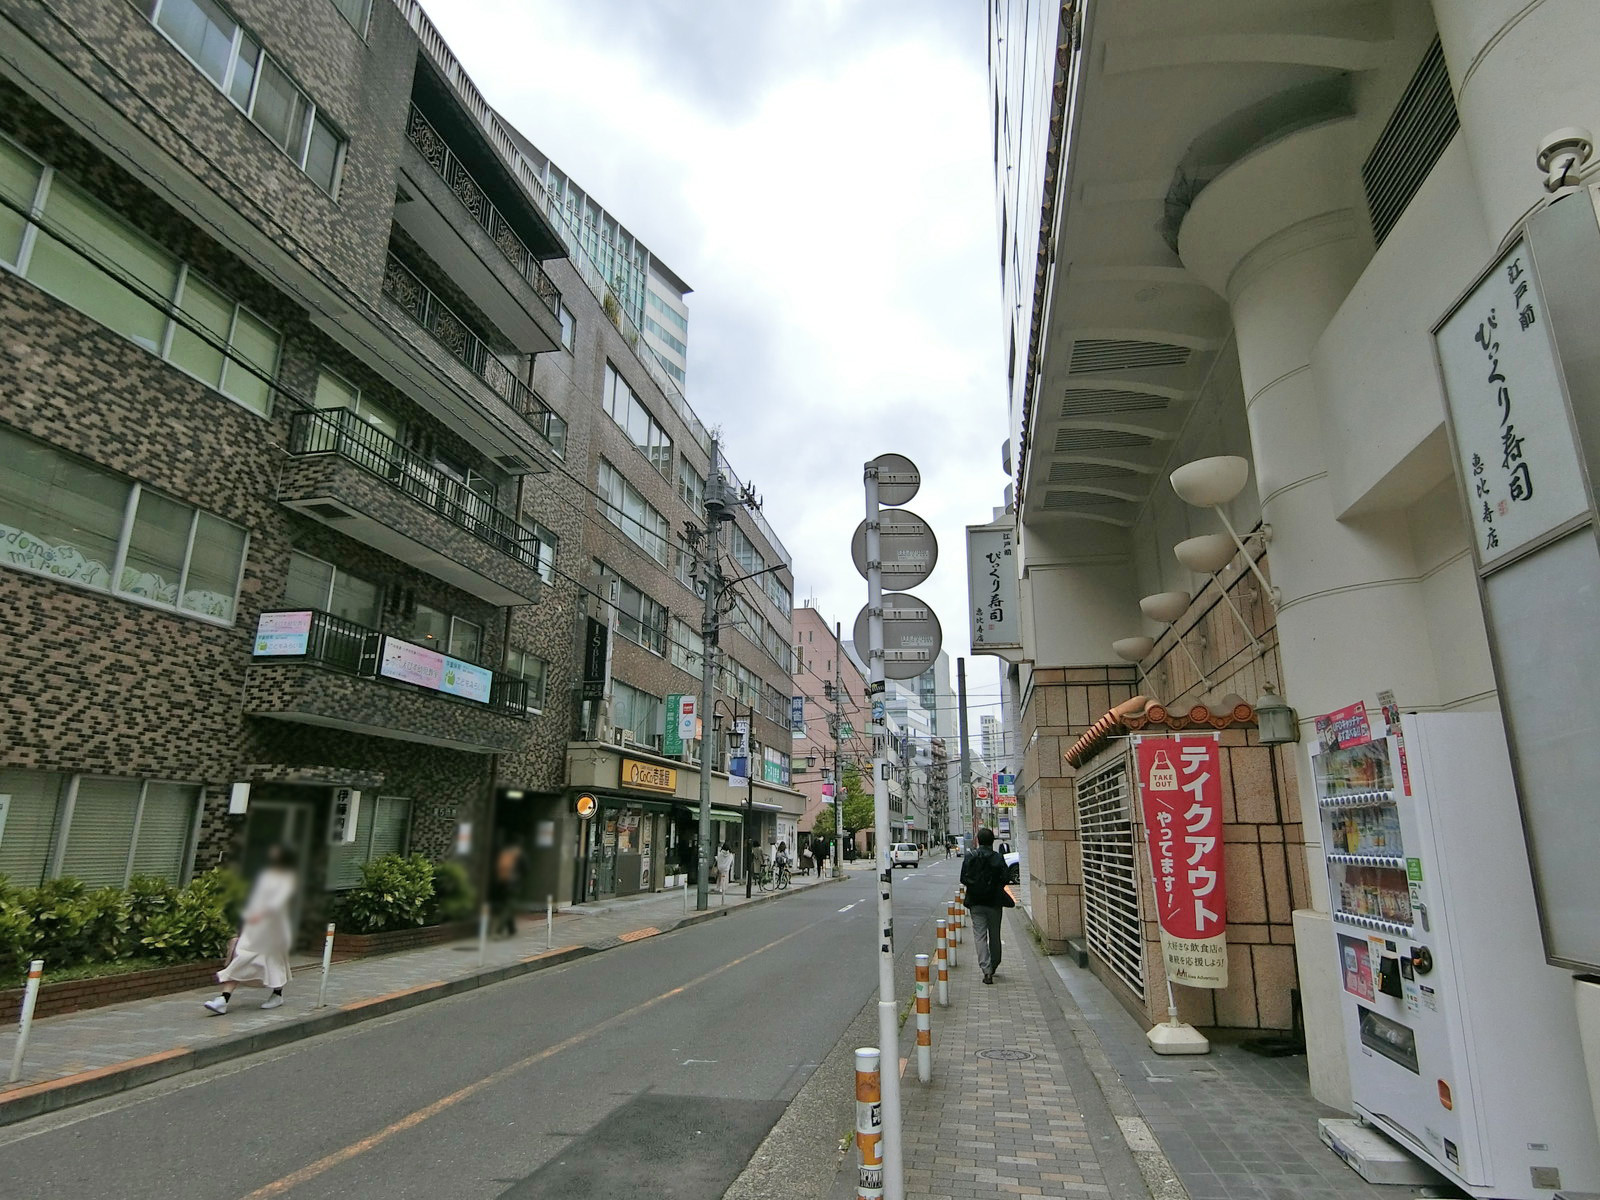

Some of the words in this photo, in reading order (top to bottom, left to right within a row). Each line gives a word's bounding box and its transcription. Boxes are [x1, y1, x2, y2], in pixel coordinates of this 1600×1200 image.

[1506, 257, 1536, 332] 江戸前
[1474, 307, 1533, 501] びっくり寿司
[1471, 453, 1501, 551] 恵比寿店
[985, 551, 1004, 622] びっくり寿司
[976, 607, 984, 642] 恵比寿店
[1180, 746, 1218, 932] テイクアウト
[1167, 940, 1223, 954] 大好きな飲食店の
